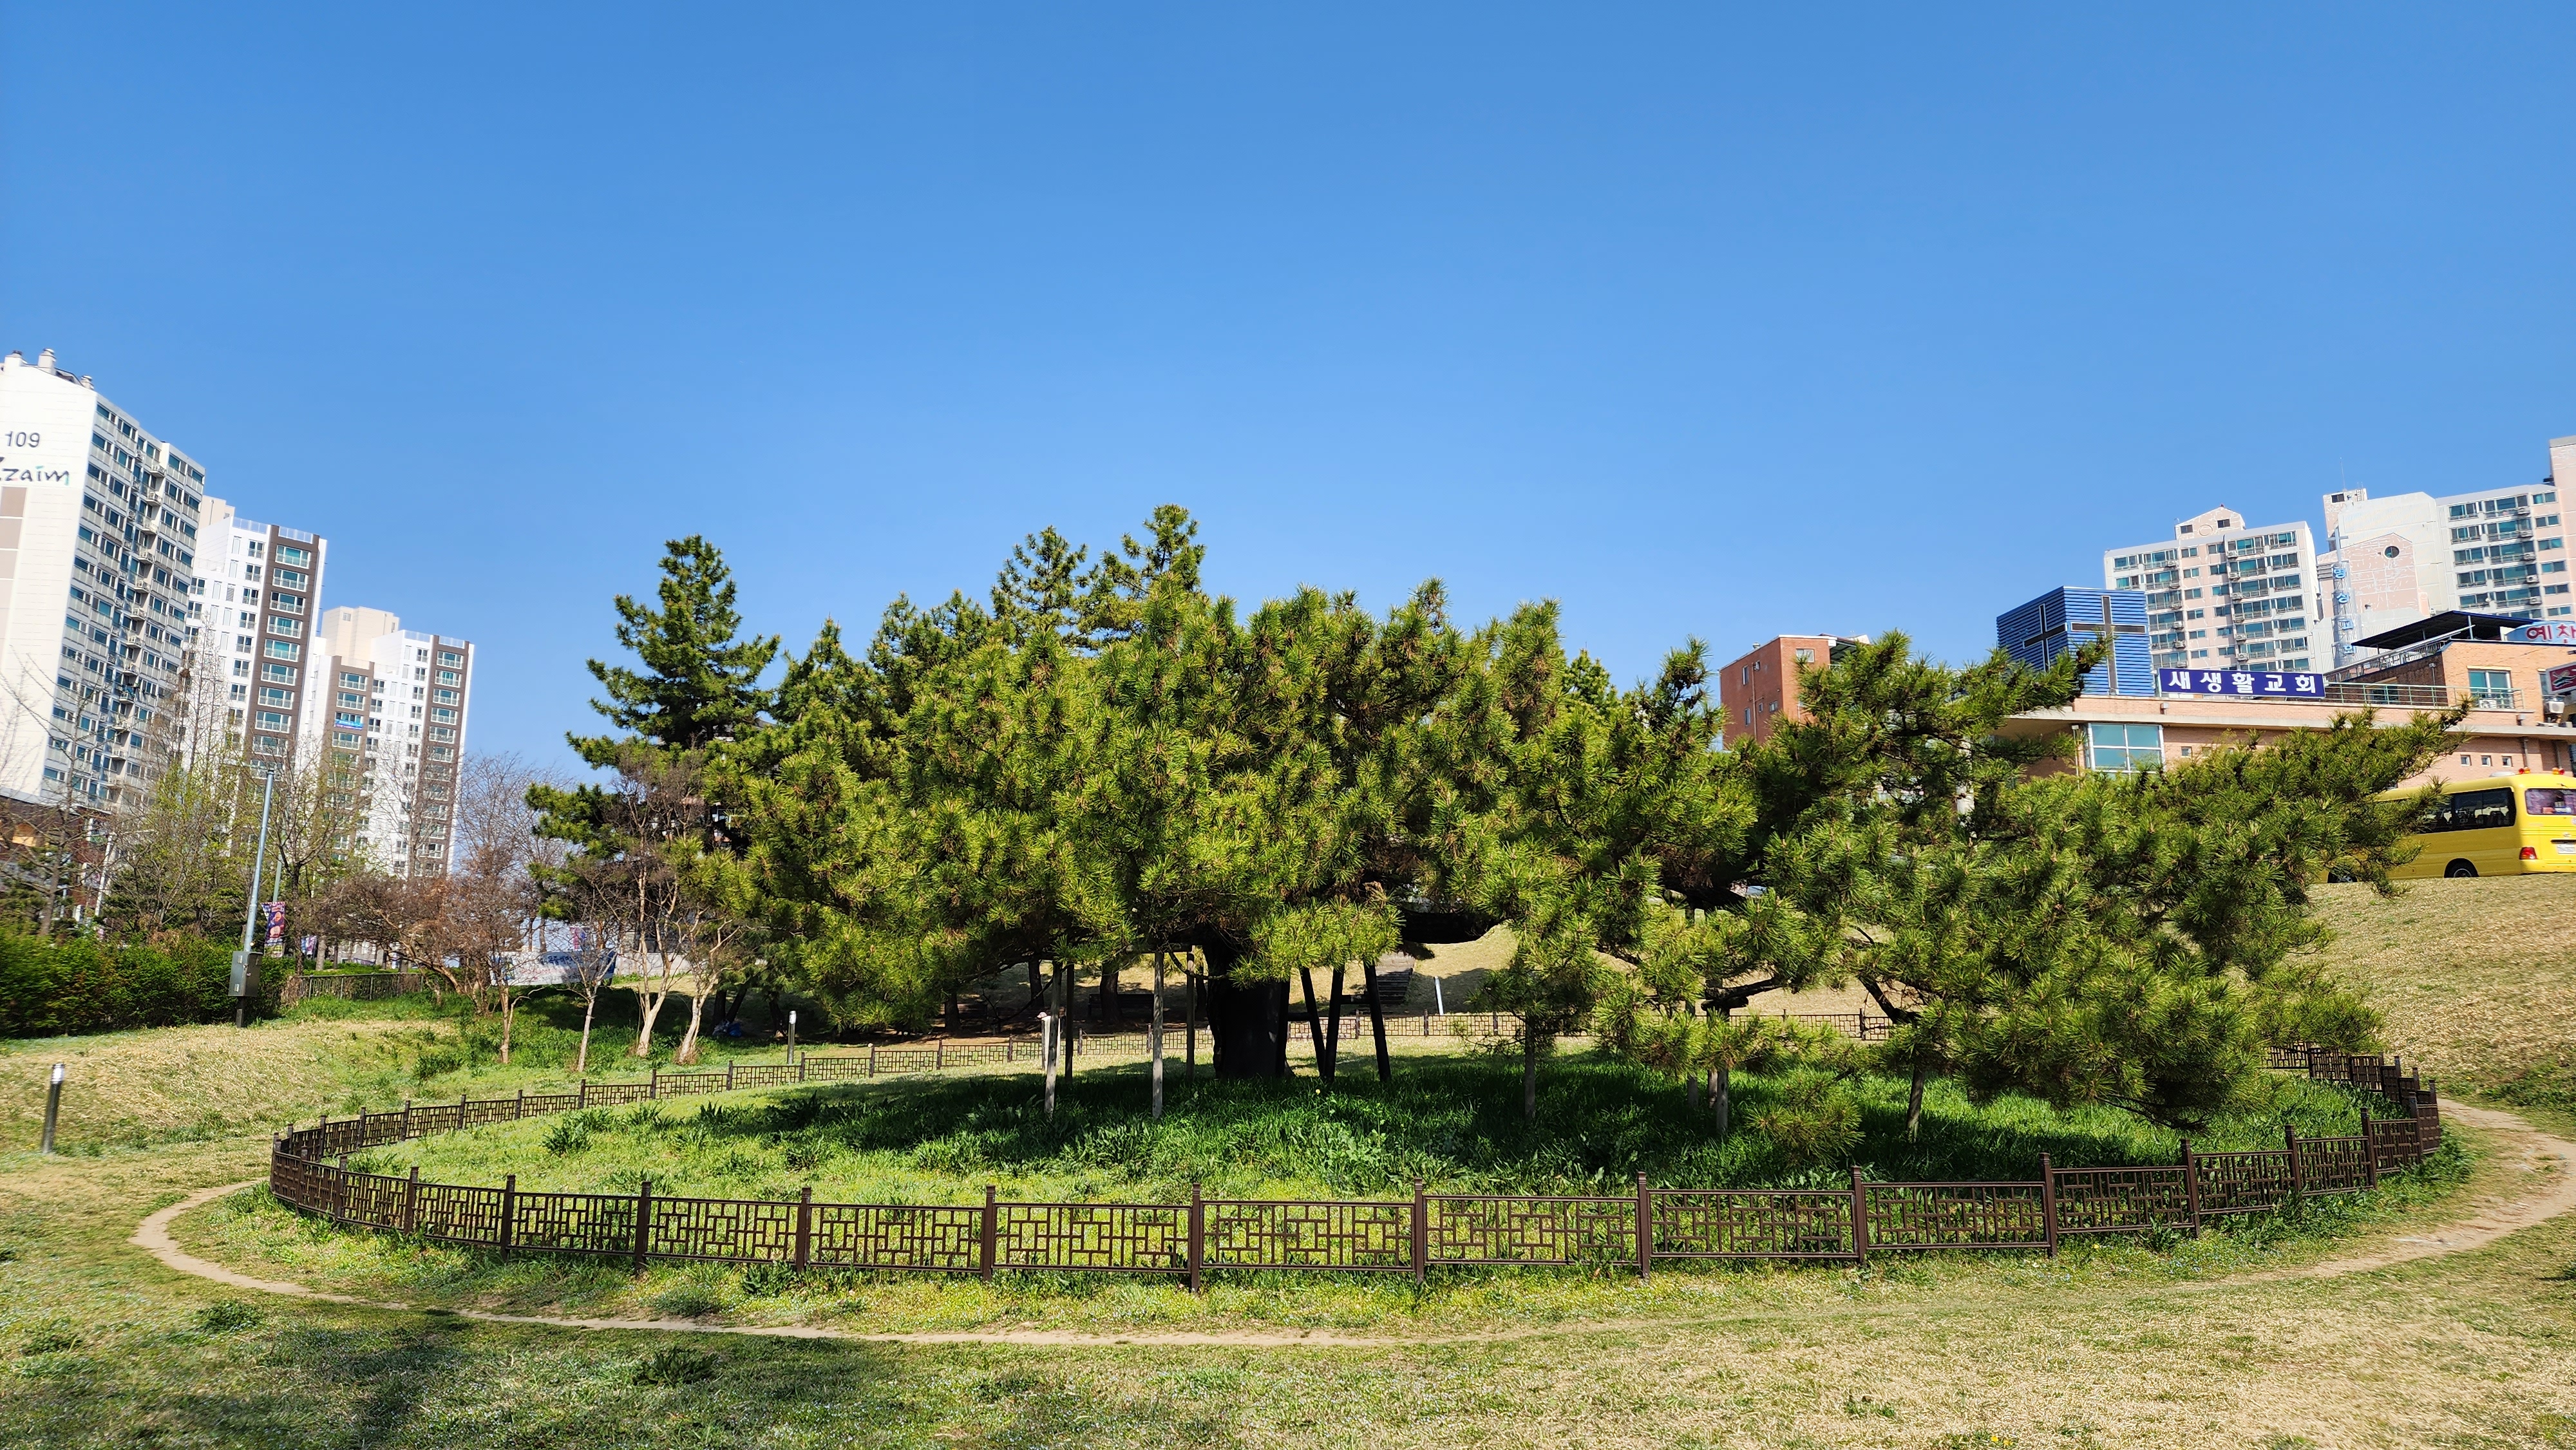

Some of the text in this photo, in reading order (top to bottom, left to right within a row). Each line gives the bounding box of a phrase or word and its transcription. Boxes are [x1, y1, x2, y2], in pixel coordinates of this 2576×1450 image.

[5, 431, 40, 447] 109
[0, 456, 70, 485] zaim
[2168, 670, 2316, 694] 새생활교회
